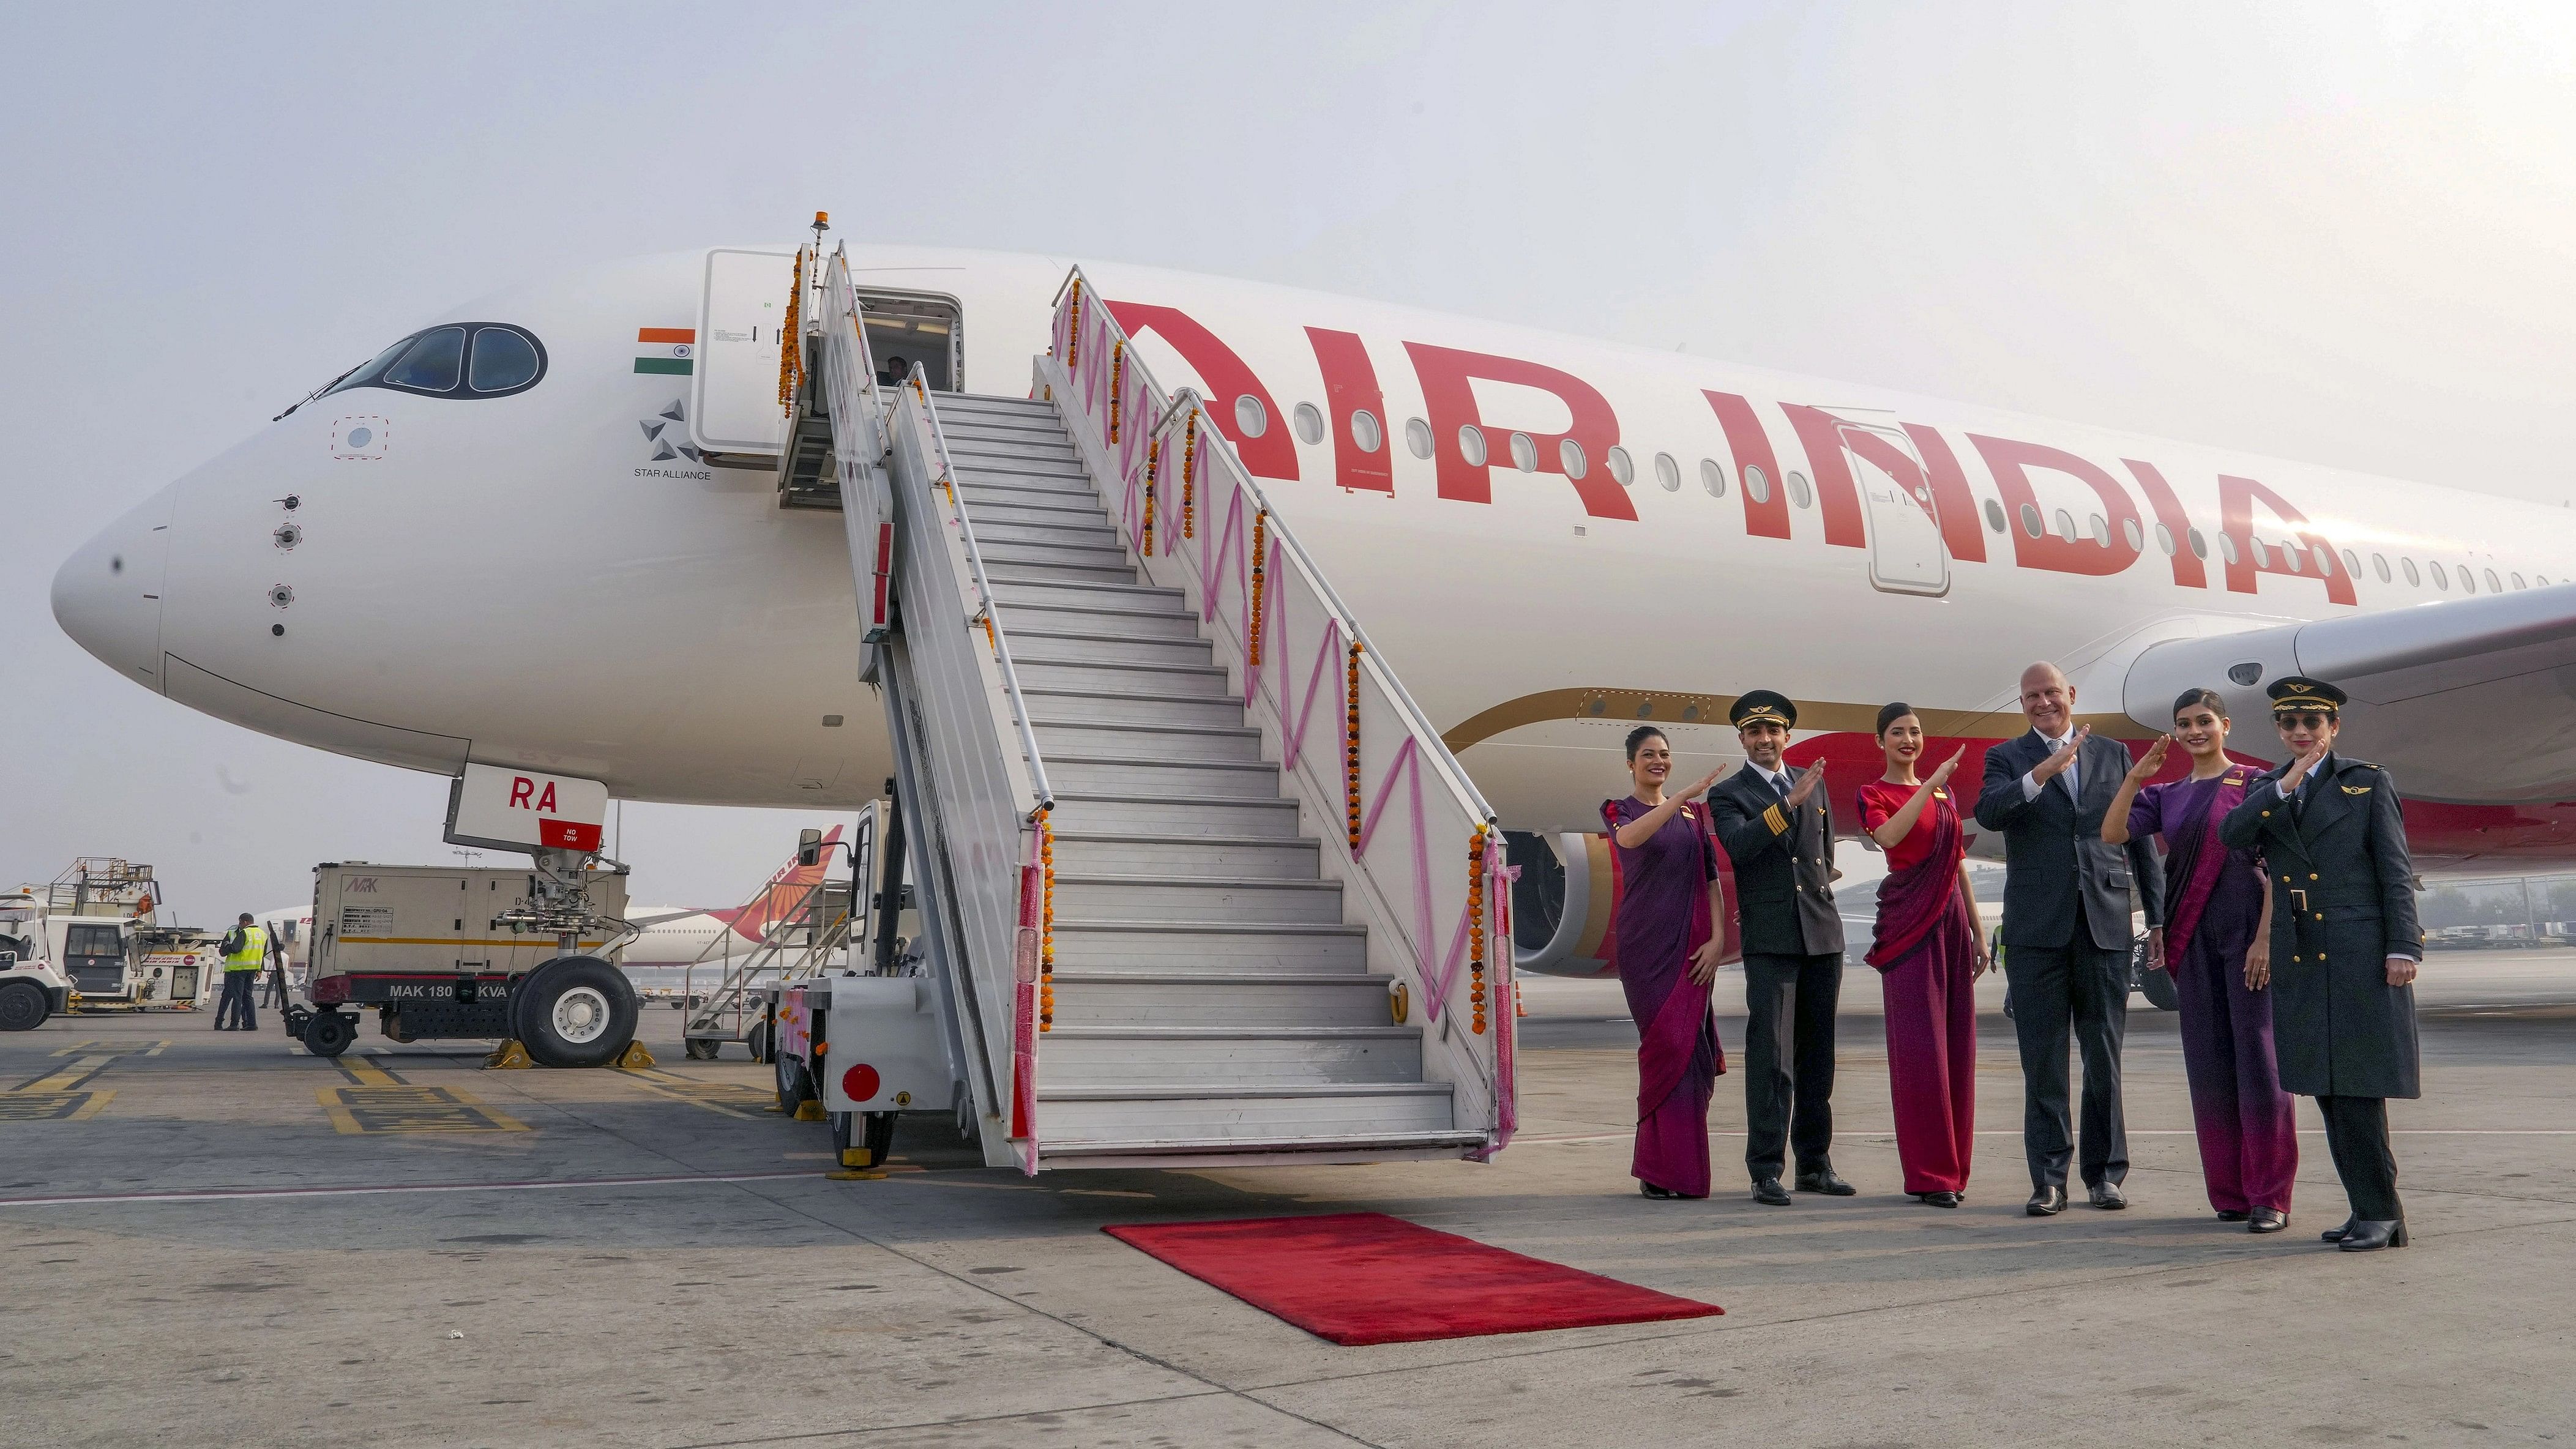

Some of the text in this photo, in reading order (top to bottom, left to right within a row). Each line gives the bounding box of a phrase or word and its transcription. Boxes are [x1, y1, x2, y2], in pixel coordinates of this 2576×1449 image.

[1102, 299, 2358, 607] AIR INDIA
[634, 468, 711, 480] STAR ALLIANCE
[509, 776, 556, 813] RA
[390, 985, 507, 997] MAK 180 KVA
